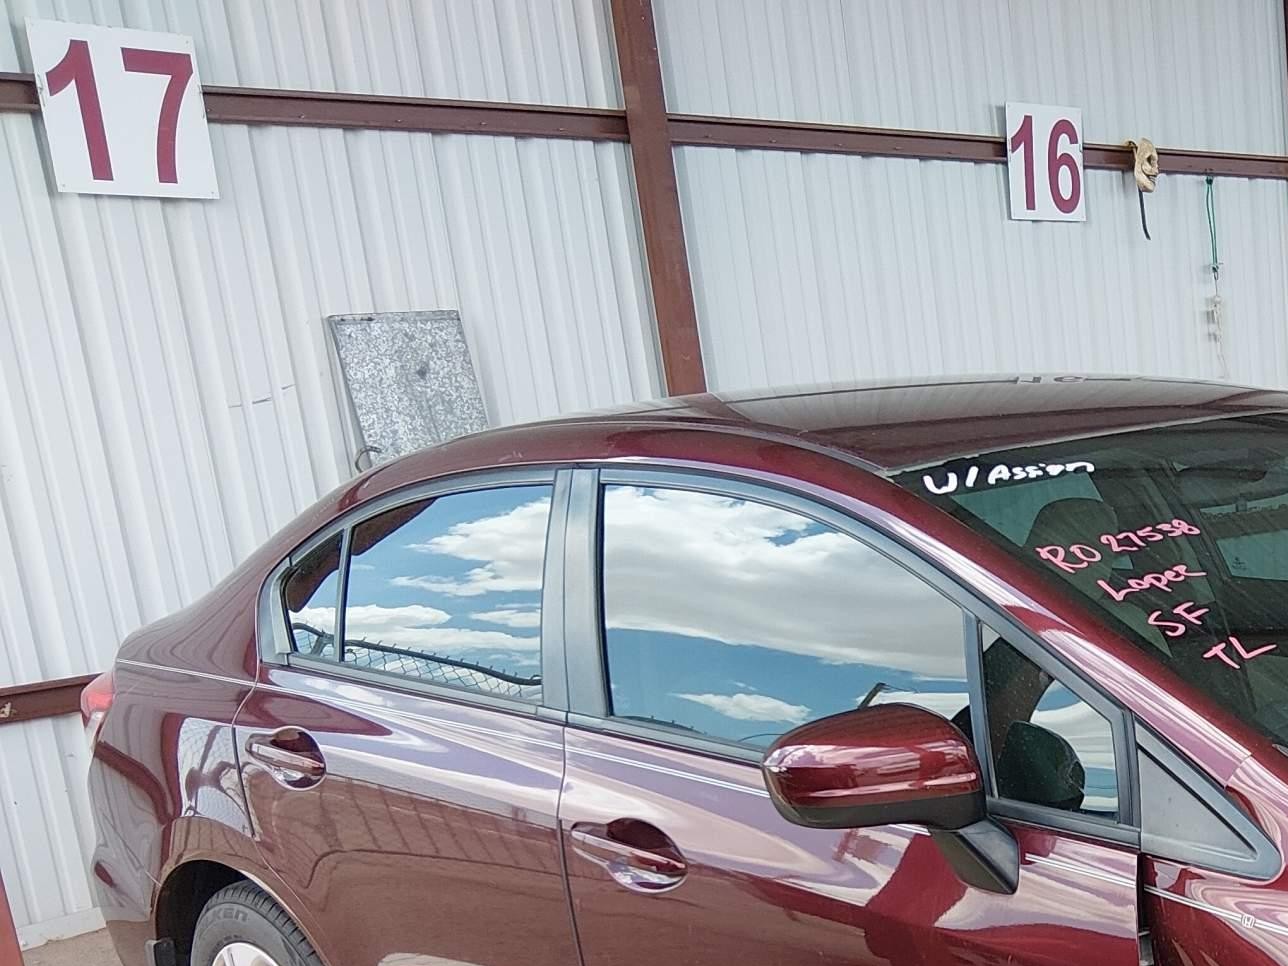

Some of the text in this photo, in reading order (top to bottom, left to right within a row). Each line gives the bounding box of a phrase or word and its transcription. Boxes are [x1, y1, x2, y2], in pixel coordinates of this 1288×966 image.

[46, 39, 193, 184] 17
[1010, 114, 1081, 214] 16
[1100, 519, 1201, 552] 27538
[1148, 601, 1209, 637] SF
[1203, 636, 1277, 669] TL
